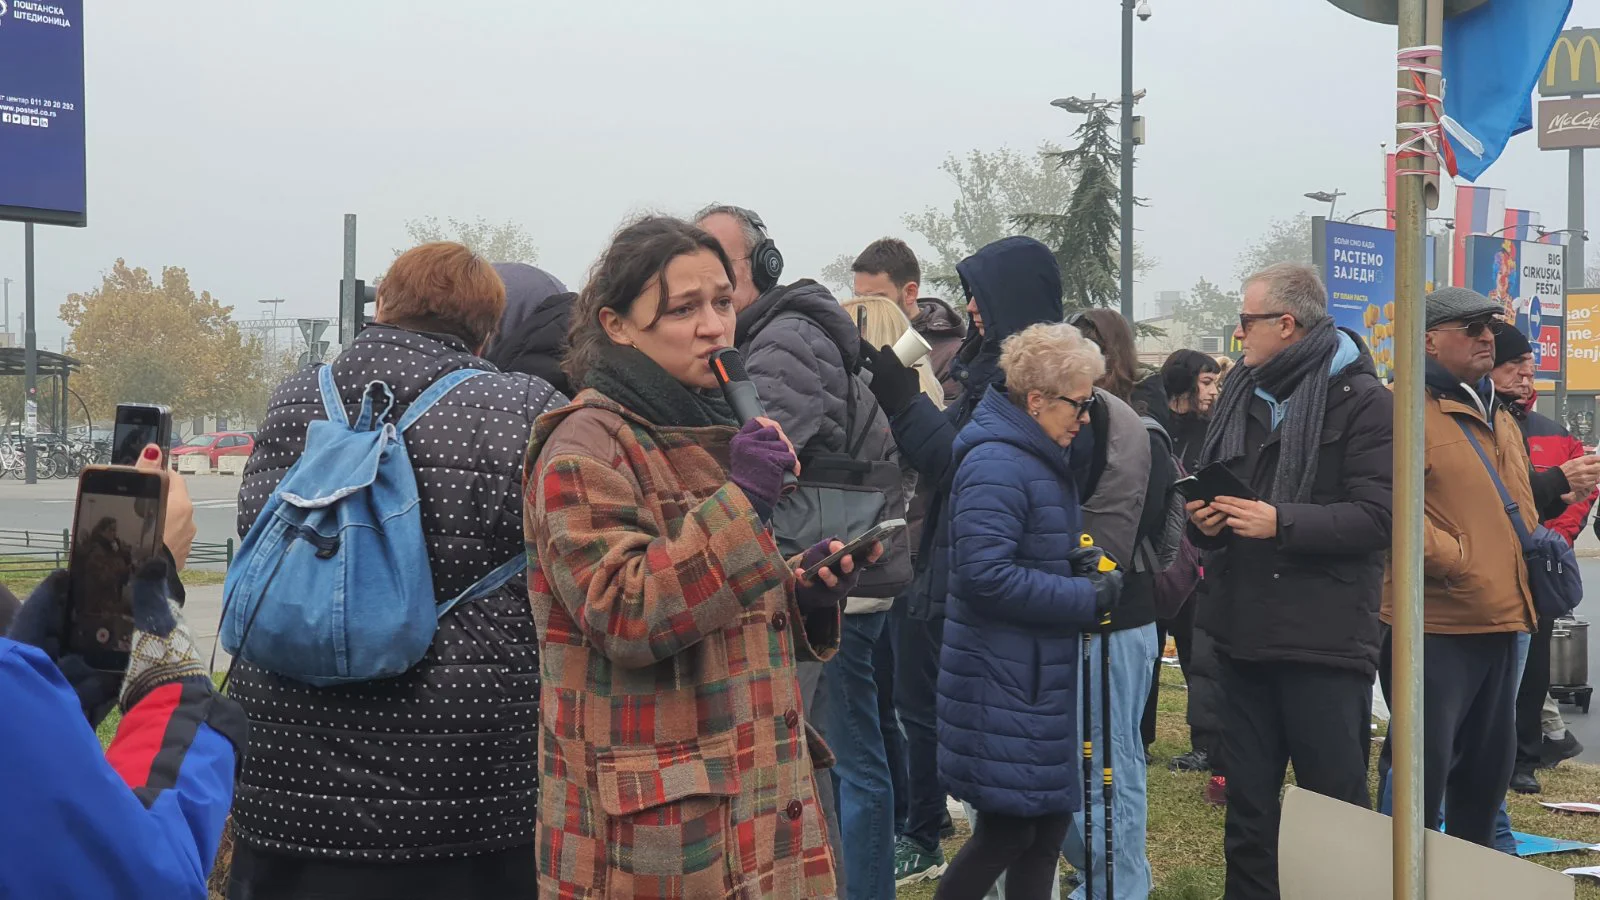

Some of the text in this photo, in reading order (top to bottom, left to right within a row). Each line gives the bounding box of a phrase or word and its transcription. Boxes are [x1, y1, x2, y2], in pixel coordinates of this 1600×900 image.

[13, 0, 64, 15] ПОШТАНСКА
[13, 10, 71, 27] ШТЕДИОНИЦА
[30, 98, 41, 106] 011
[1334, 248, 1384, 267] РАСТЕМО
[1548, 253, 1561, 265] BIG
[1523, 266, 1561, 281] CIRKUSKA
[1536, 280, 1561, 296] FEŠTA!
[1541, 335, 1557, 357] BIG
[1567, 343, 1600, 363] čenj
